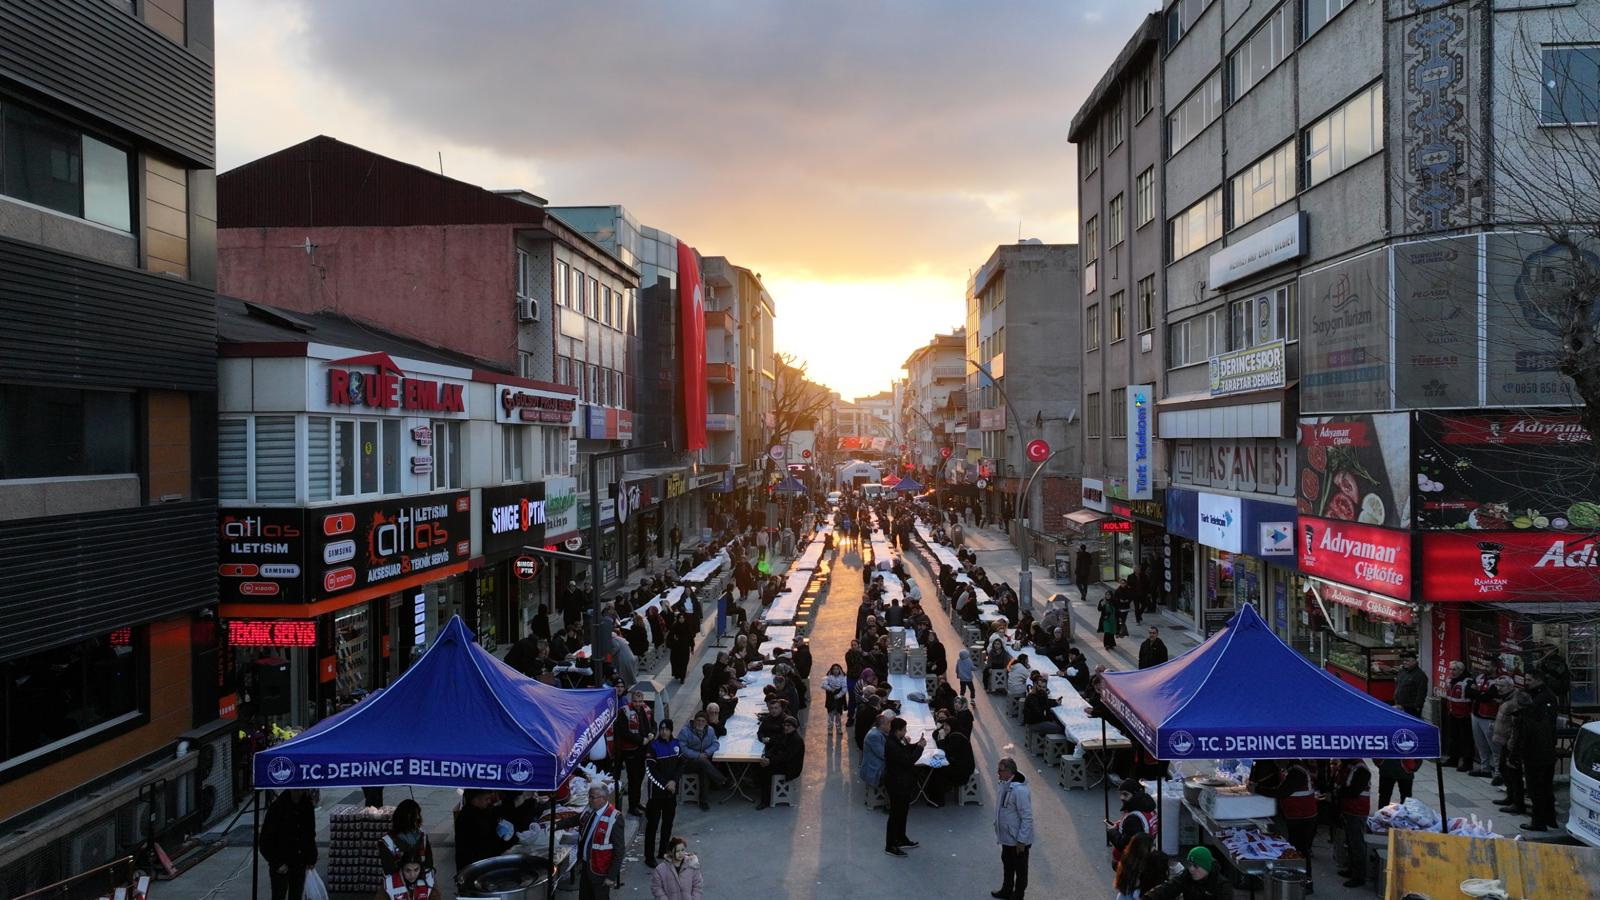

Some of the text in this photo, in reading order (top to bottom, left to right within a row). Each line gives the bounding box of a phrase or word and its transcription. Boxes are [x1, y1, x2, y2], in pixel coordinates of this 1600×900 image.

[401, 378, 465, 413] EMLAK
[1135, 406, 1147, 462] Telekom
[1180, 450, 1191, 468] TV
[226, 516, 301, 537] atlas
[378, 507, 448, 557] atlas
[1103, 522, 1130, 530] KOLYE
[328, 545, 353, 558] SAMSUNG
[1320, 527, 1397, 564] Adıyaman
[368, 563, 401, 583] AKSESUAR
[1354, 561, 1404, 586] Çiğköfte
[1474, 578, 1507, 586] RAMAZAN
[1331, 589, 1363, 608] Adıyaman
[1366, 600, 1397, 618] Çiğköfte
[1198, 736, 1223, 751] T.C.
[299, 764, 325, 780] T.C.
